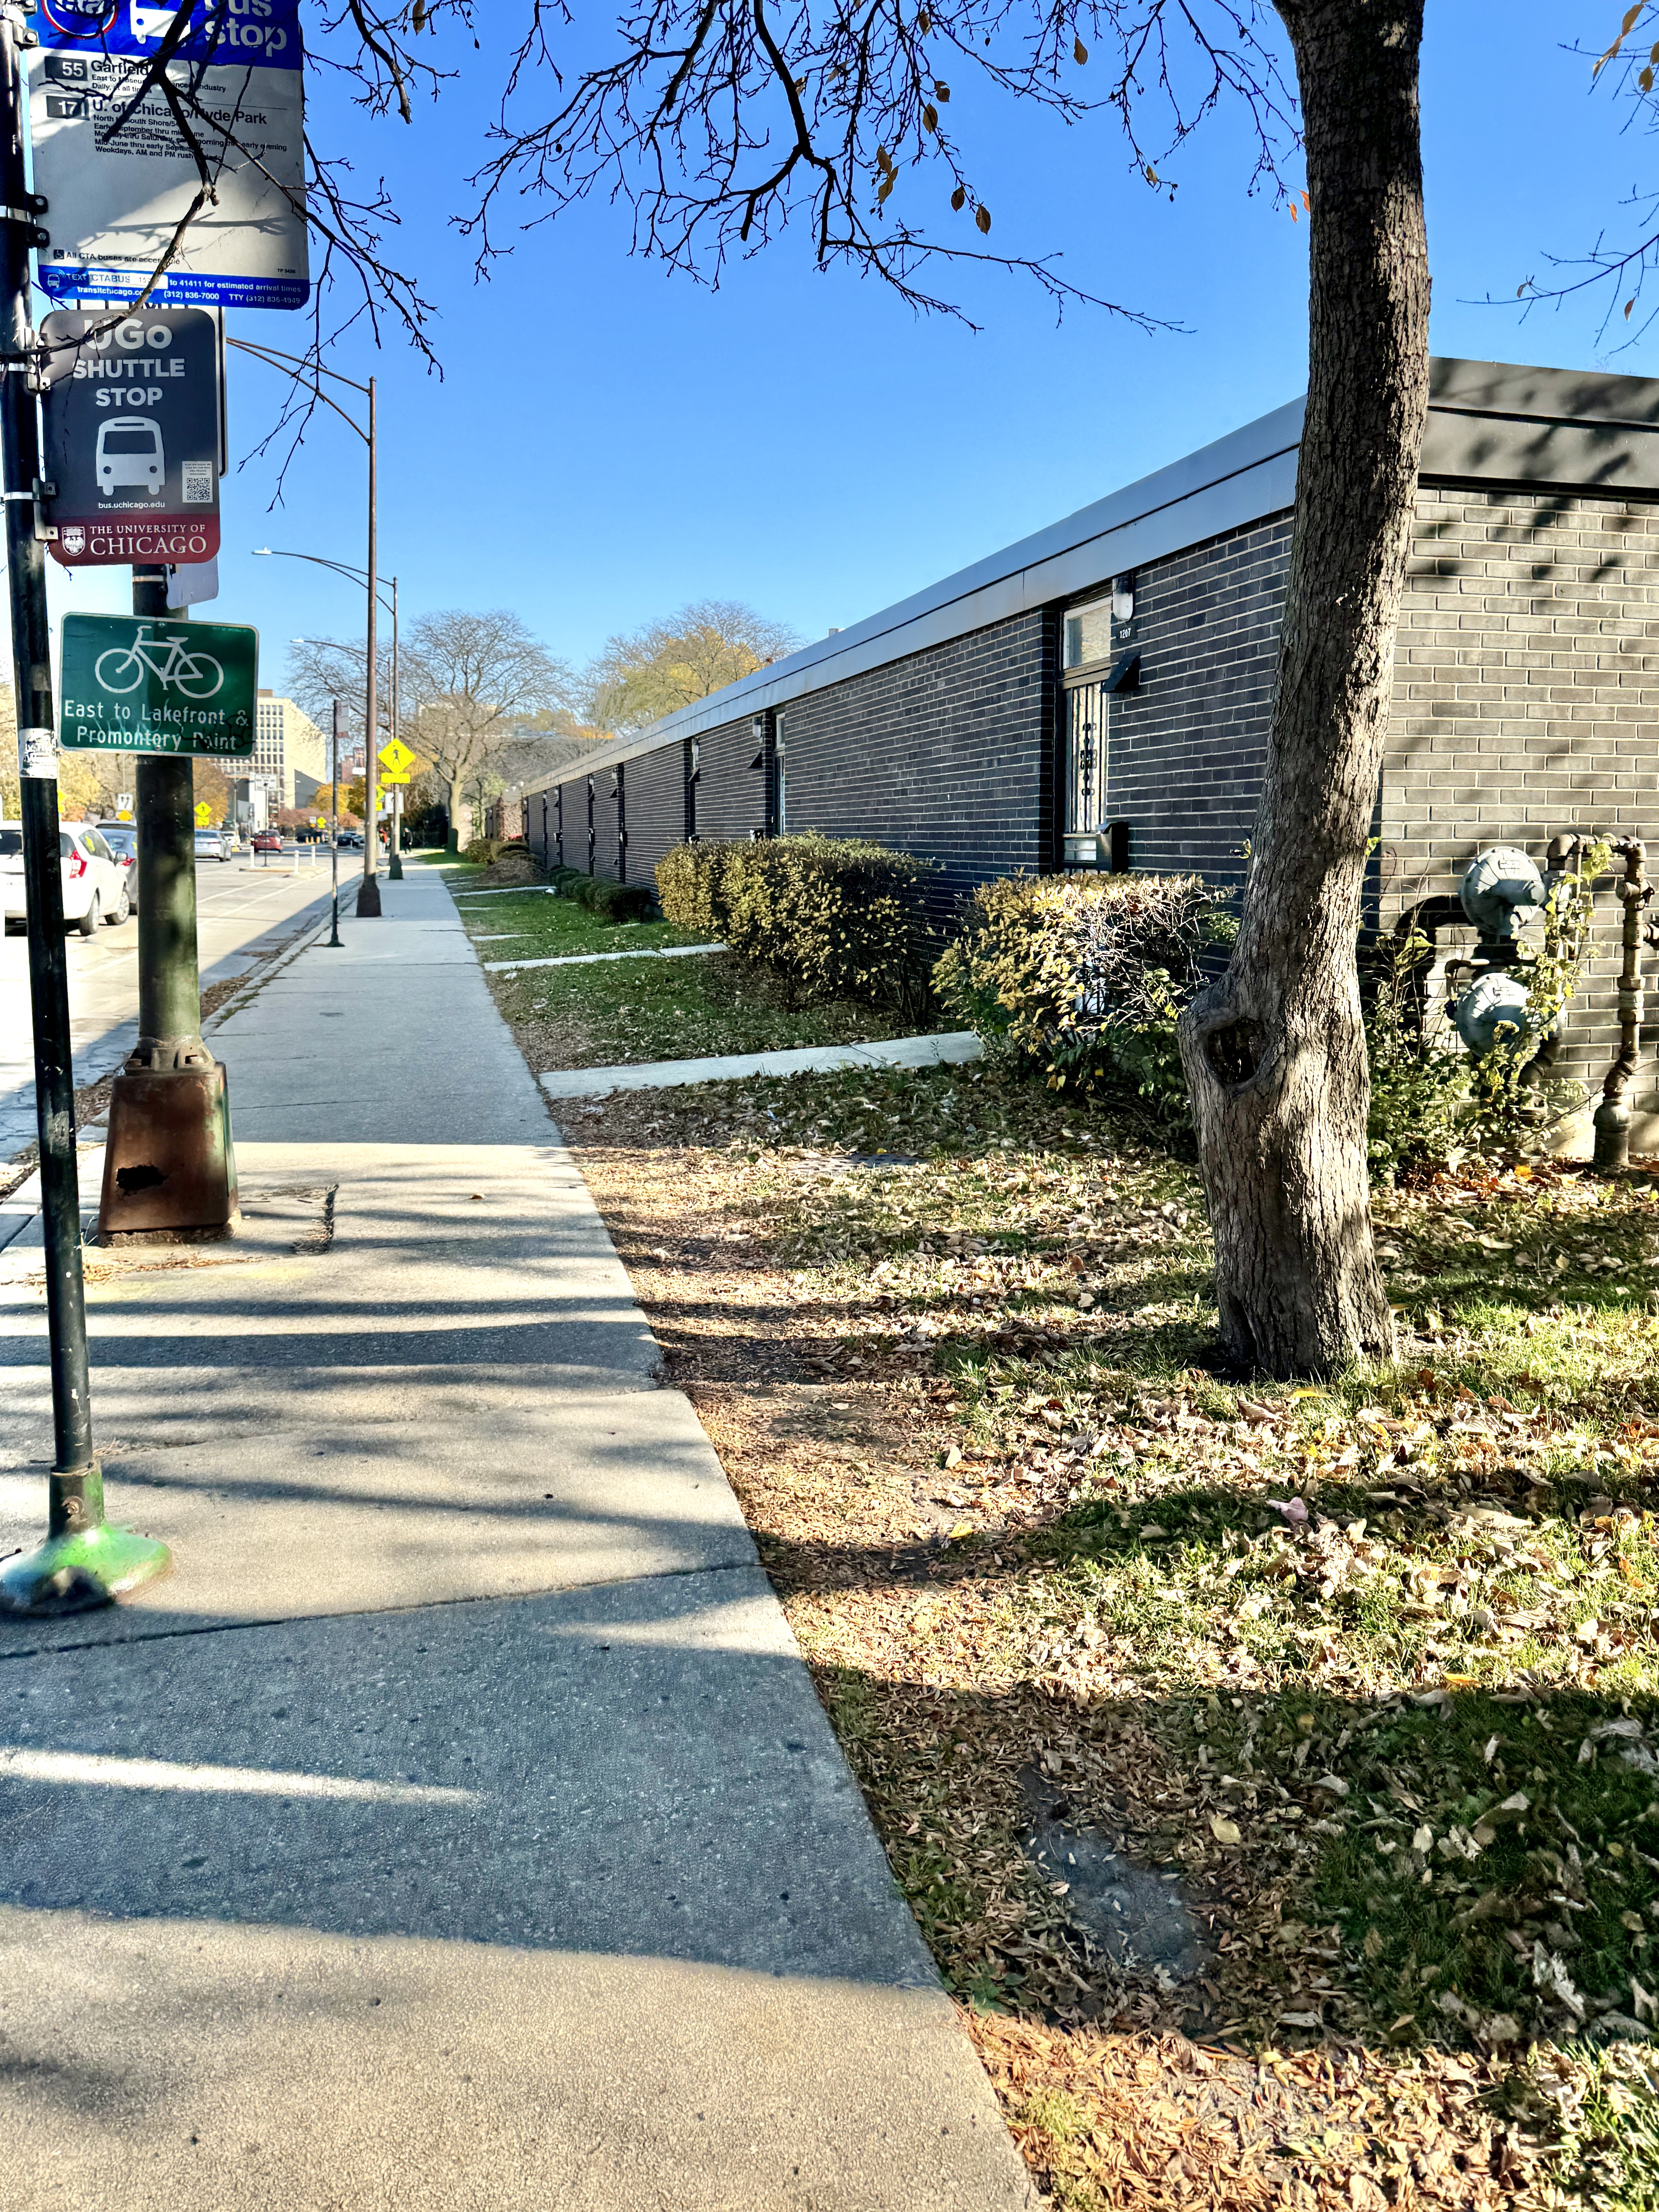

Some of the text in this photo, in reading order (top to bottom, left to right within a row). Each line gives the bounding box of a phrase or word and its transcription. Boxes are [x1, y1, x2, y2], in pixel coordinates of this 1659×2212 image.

[205, 18, 287, 57] stop
[62, 62, 83, 77] 55
[91, 60, 151, 75] Garfield
[200, 84, 226, 93] ndustry
[93, 99, 107, 111] U.
[236, 111, 267, 124] Park
[95, 138, 128, 147] Mid-June
[95, 146, 134, 155] Weekdays,
[91, 274, 130, 283] CTABUS
[164, 290, 183, 299] (312)
[246, 295, 264, 303] (312)
[84, 319, 172, 350] UGo
[73, 358, 185, 378] SHUTTLE
[96, 387, 163, 406] STOP
[98, 501, 165, 509] bus.uchicago.edu
[90, 524, 205, 534] THE UNIVERSITY OF
[90, 536, 206, 555] CHICAGO
[1120, 628, 1131, 638] 1207
[65, 699, 248, 726] East to Lakefront &
[77, 726, 181, 752] Promontory
